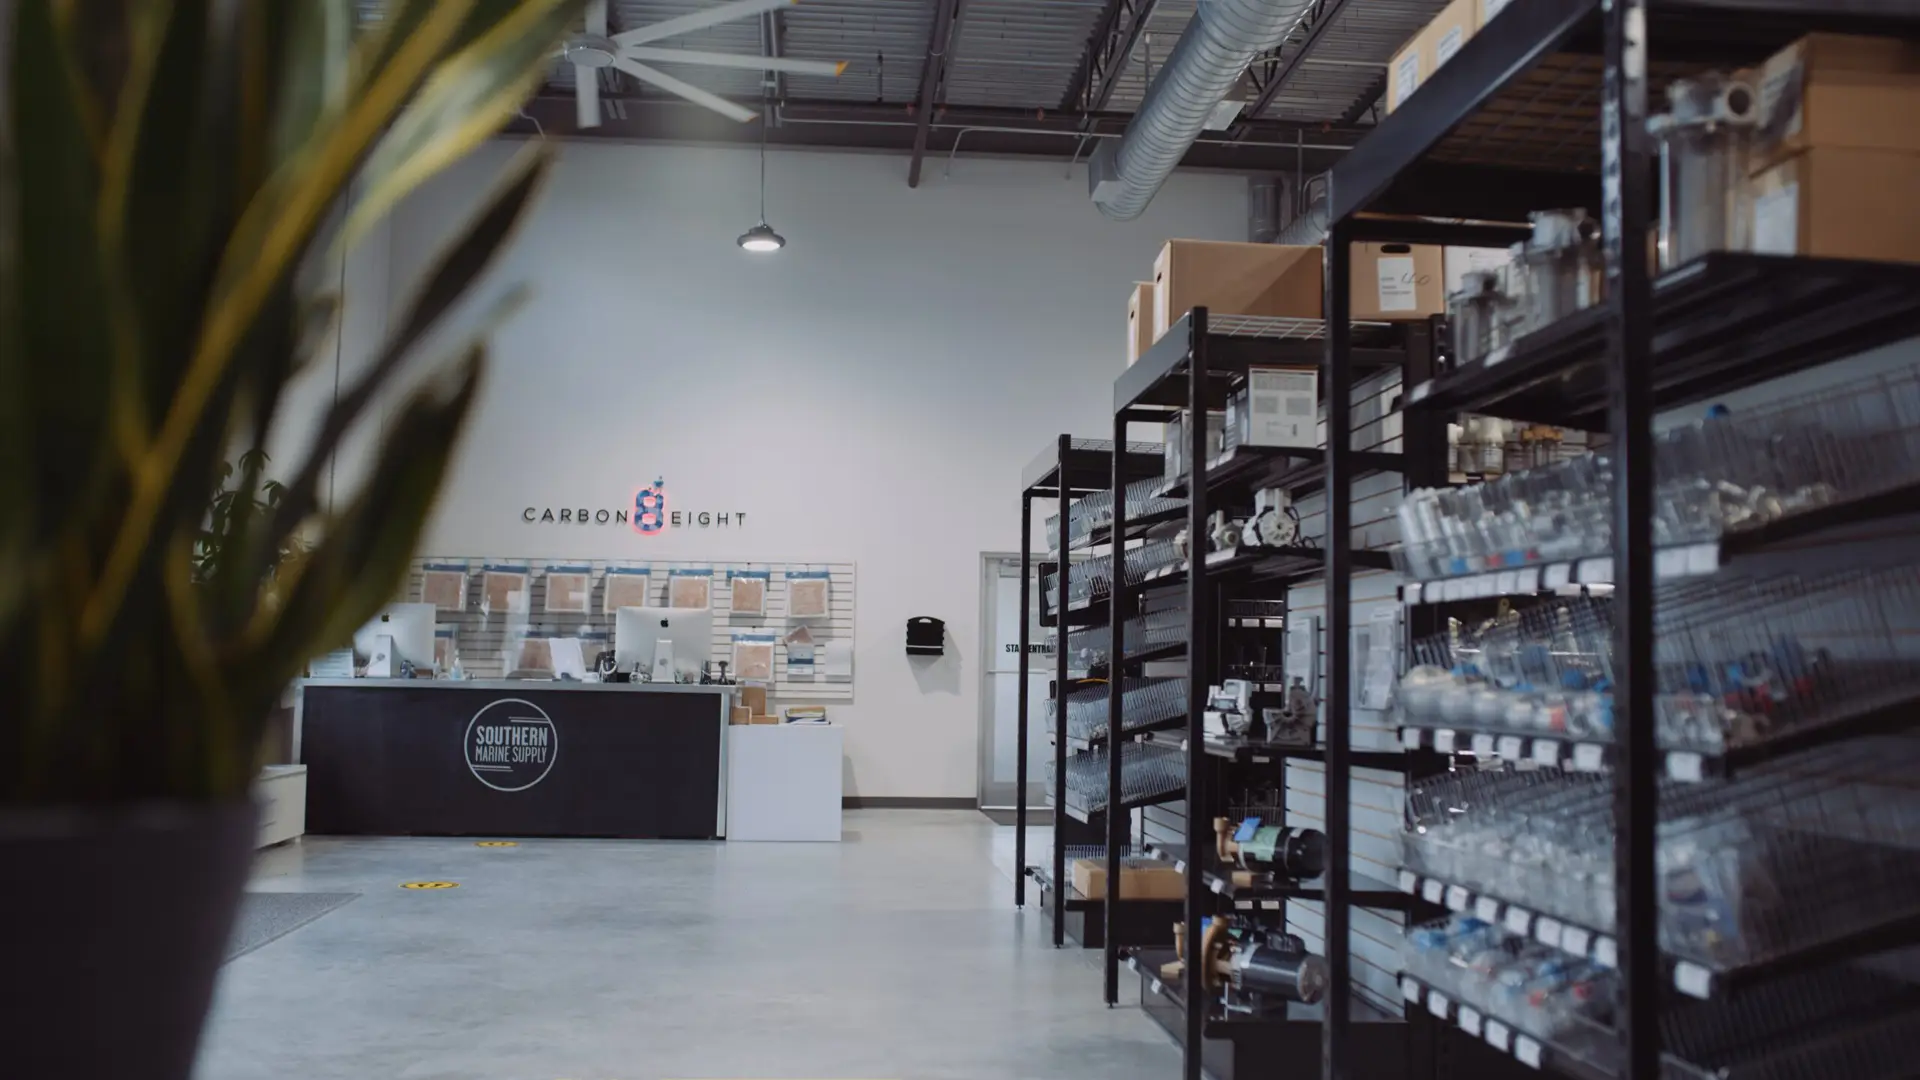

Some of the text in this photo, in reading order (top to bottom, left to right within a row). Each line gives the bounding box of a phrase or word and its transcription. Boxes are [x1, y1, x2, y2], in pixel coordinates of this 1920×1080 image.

[523, 507, 628, 525] CARBON
[671, 511, 747, 527] EIGHT
[476, 725, 548, 747] SOUTHERN
[475, 745, 547, 764] MARINE SUPPLY
